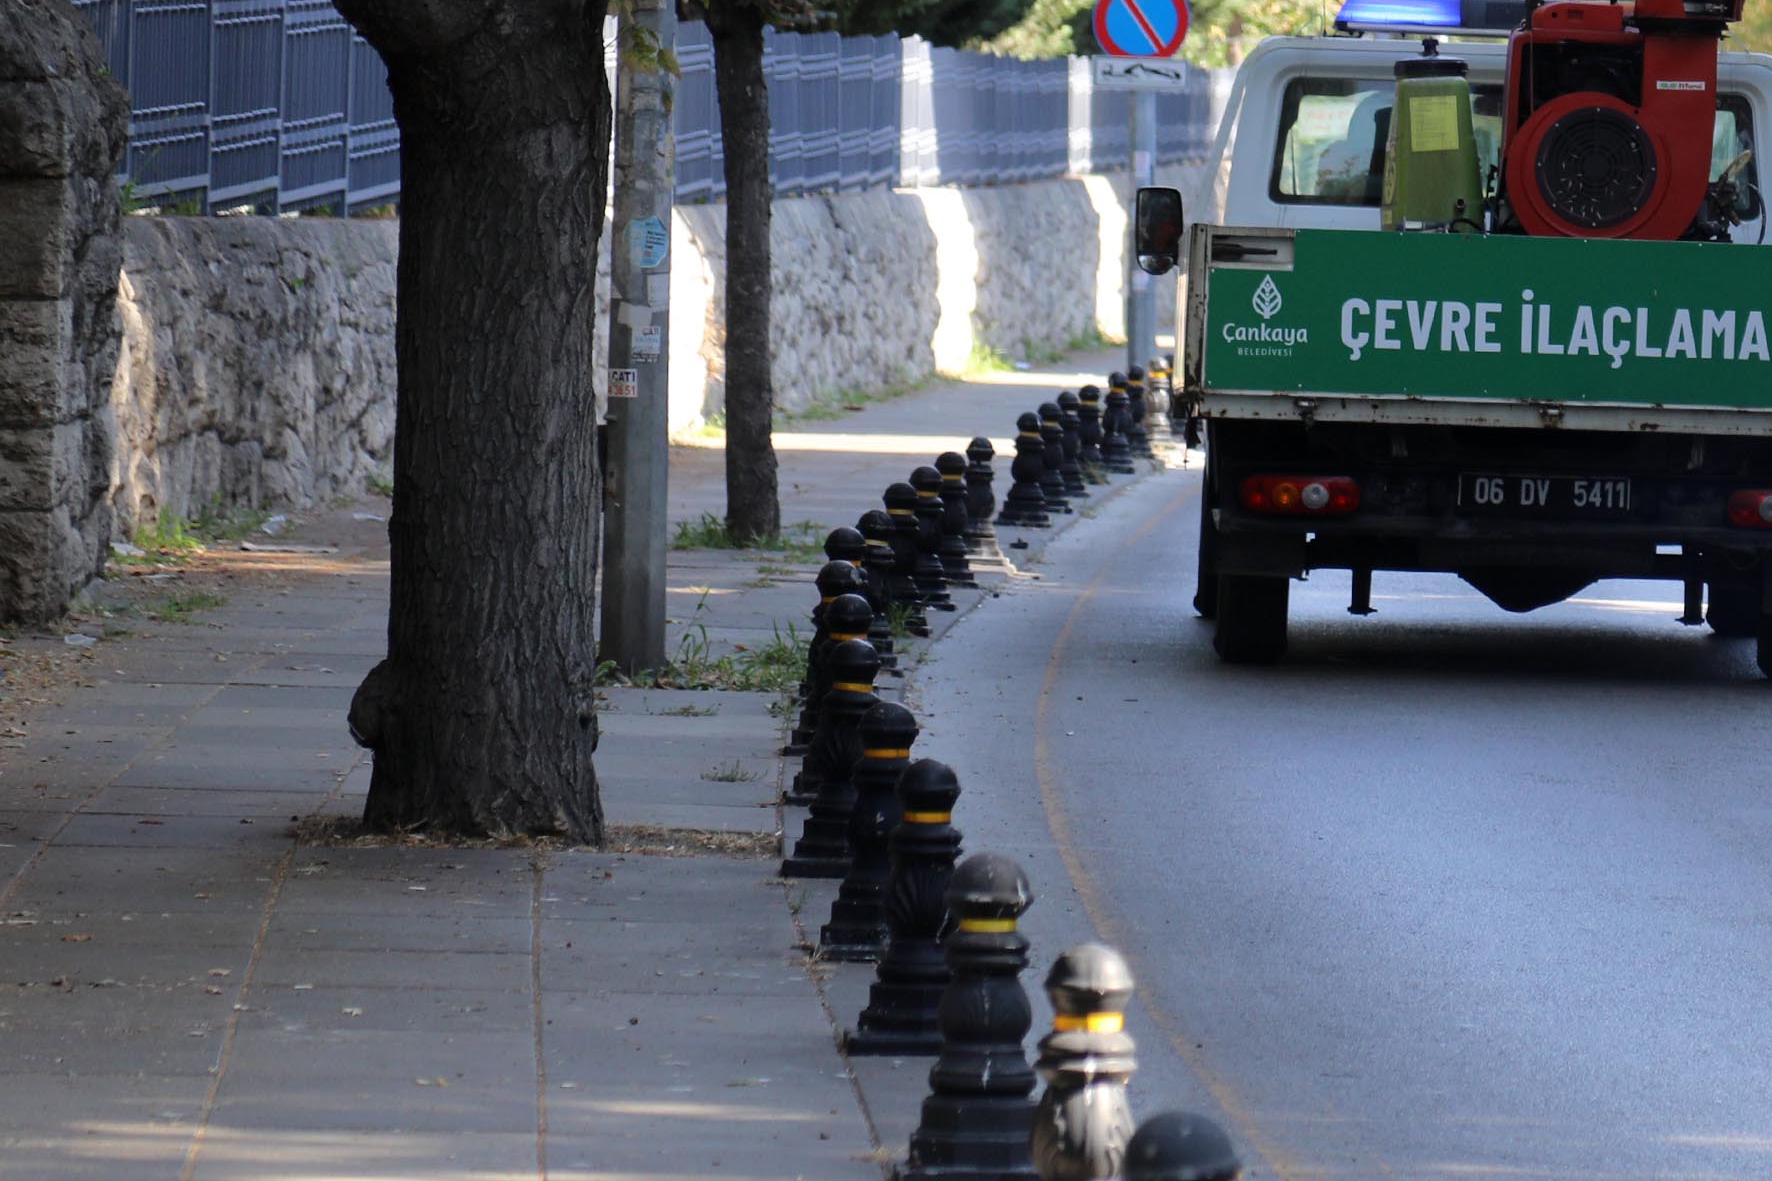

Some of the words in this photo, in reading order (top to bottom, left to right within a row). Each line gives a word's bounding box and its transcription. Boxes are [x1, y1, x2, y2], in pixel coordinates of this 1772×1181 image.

[1222, 322, 1308, 346] Çankaya
[1340, 297, 1503, 361] ÇEVRE
[1520, 288, 1771, 369] İLAÇLAMA
[1474, 477, 1504, 505] 06
[1520, 479, 1550, 506] DV
[1573, 480, 1625, 508] 5411
